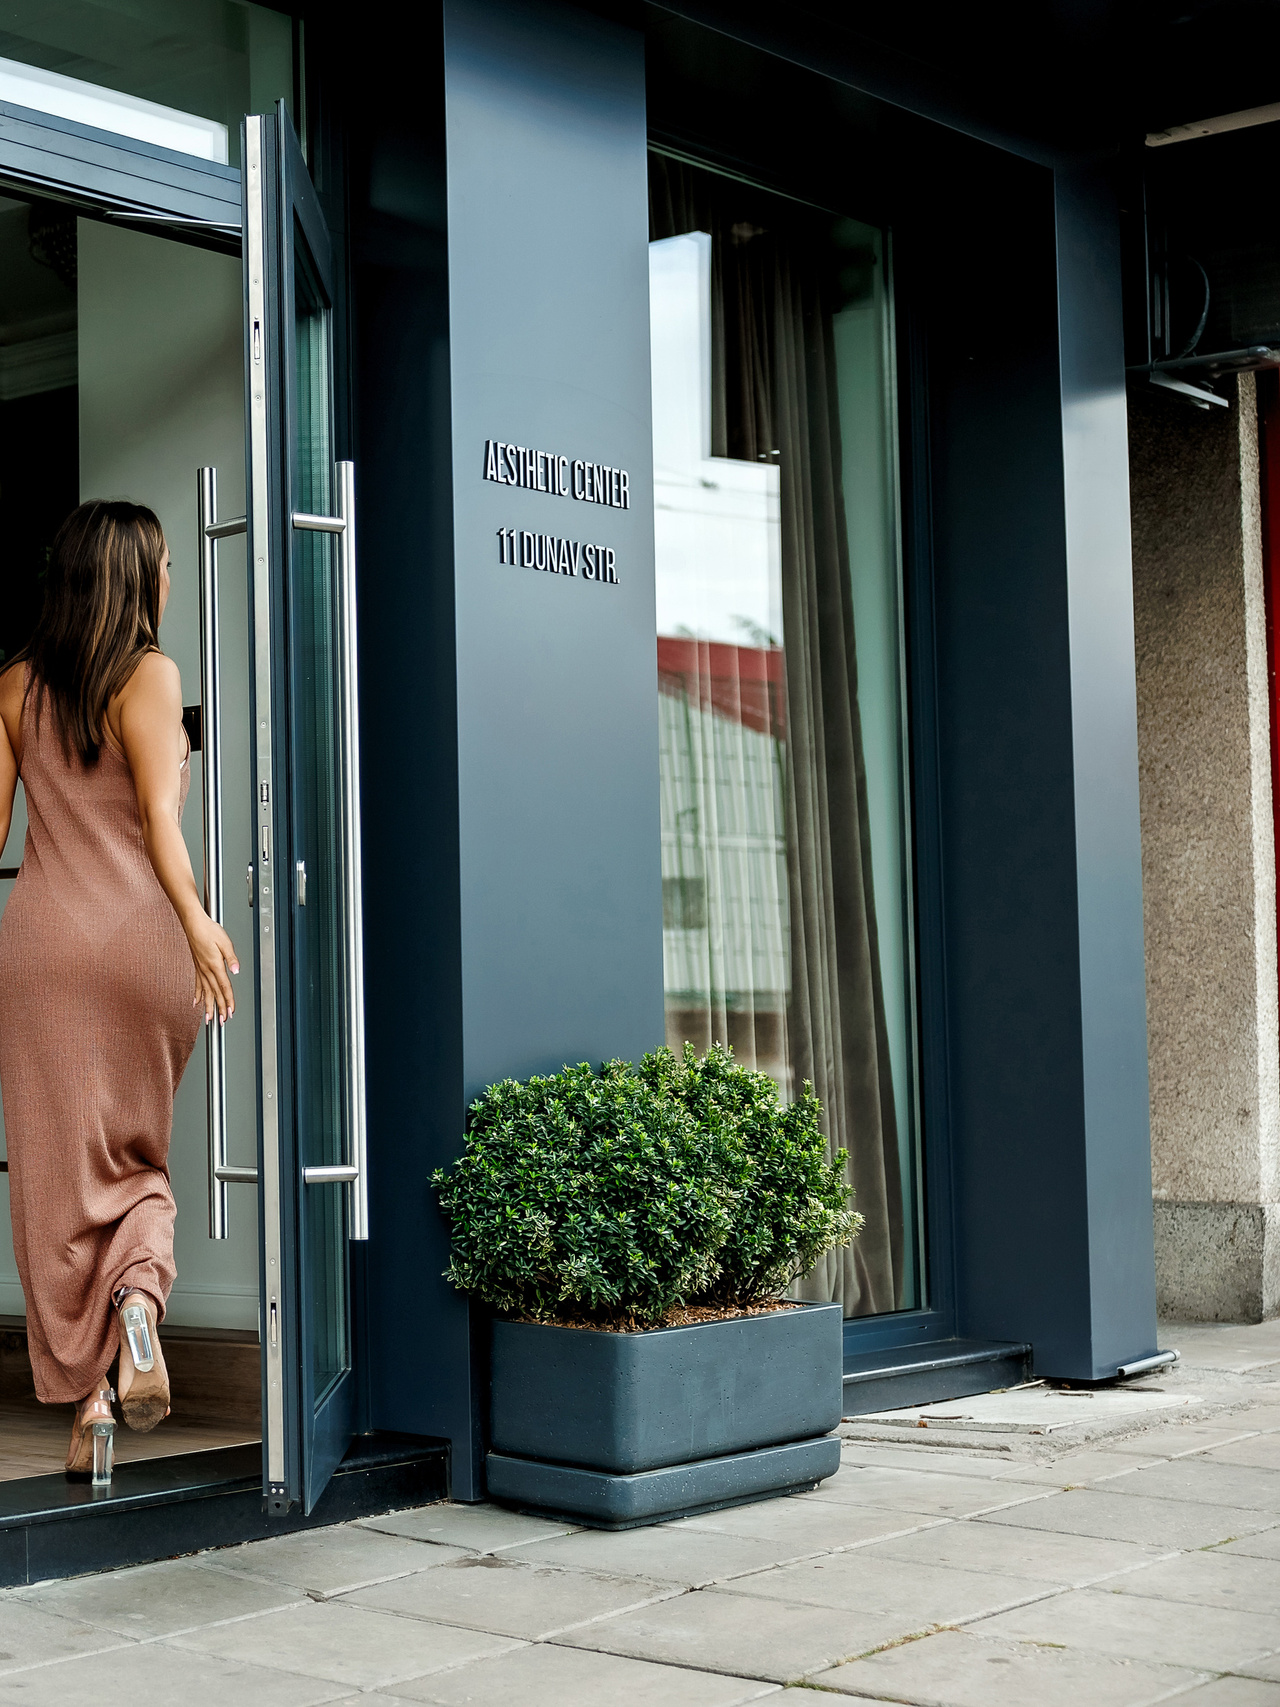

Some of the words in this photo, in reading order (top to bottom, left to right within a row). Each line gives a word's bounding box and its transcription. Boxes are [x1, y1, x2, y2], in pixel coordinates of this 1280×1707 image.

[484, 439, 569, 497] AESTHETIC
[572, 459, 630, 510] CENTER
[497, 527, 517, 565] 11
[520, 531, 581, 577] DUNAV
[582, 543, 621, 584] STR.
